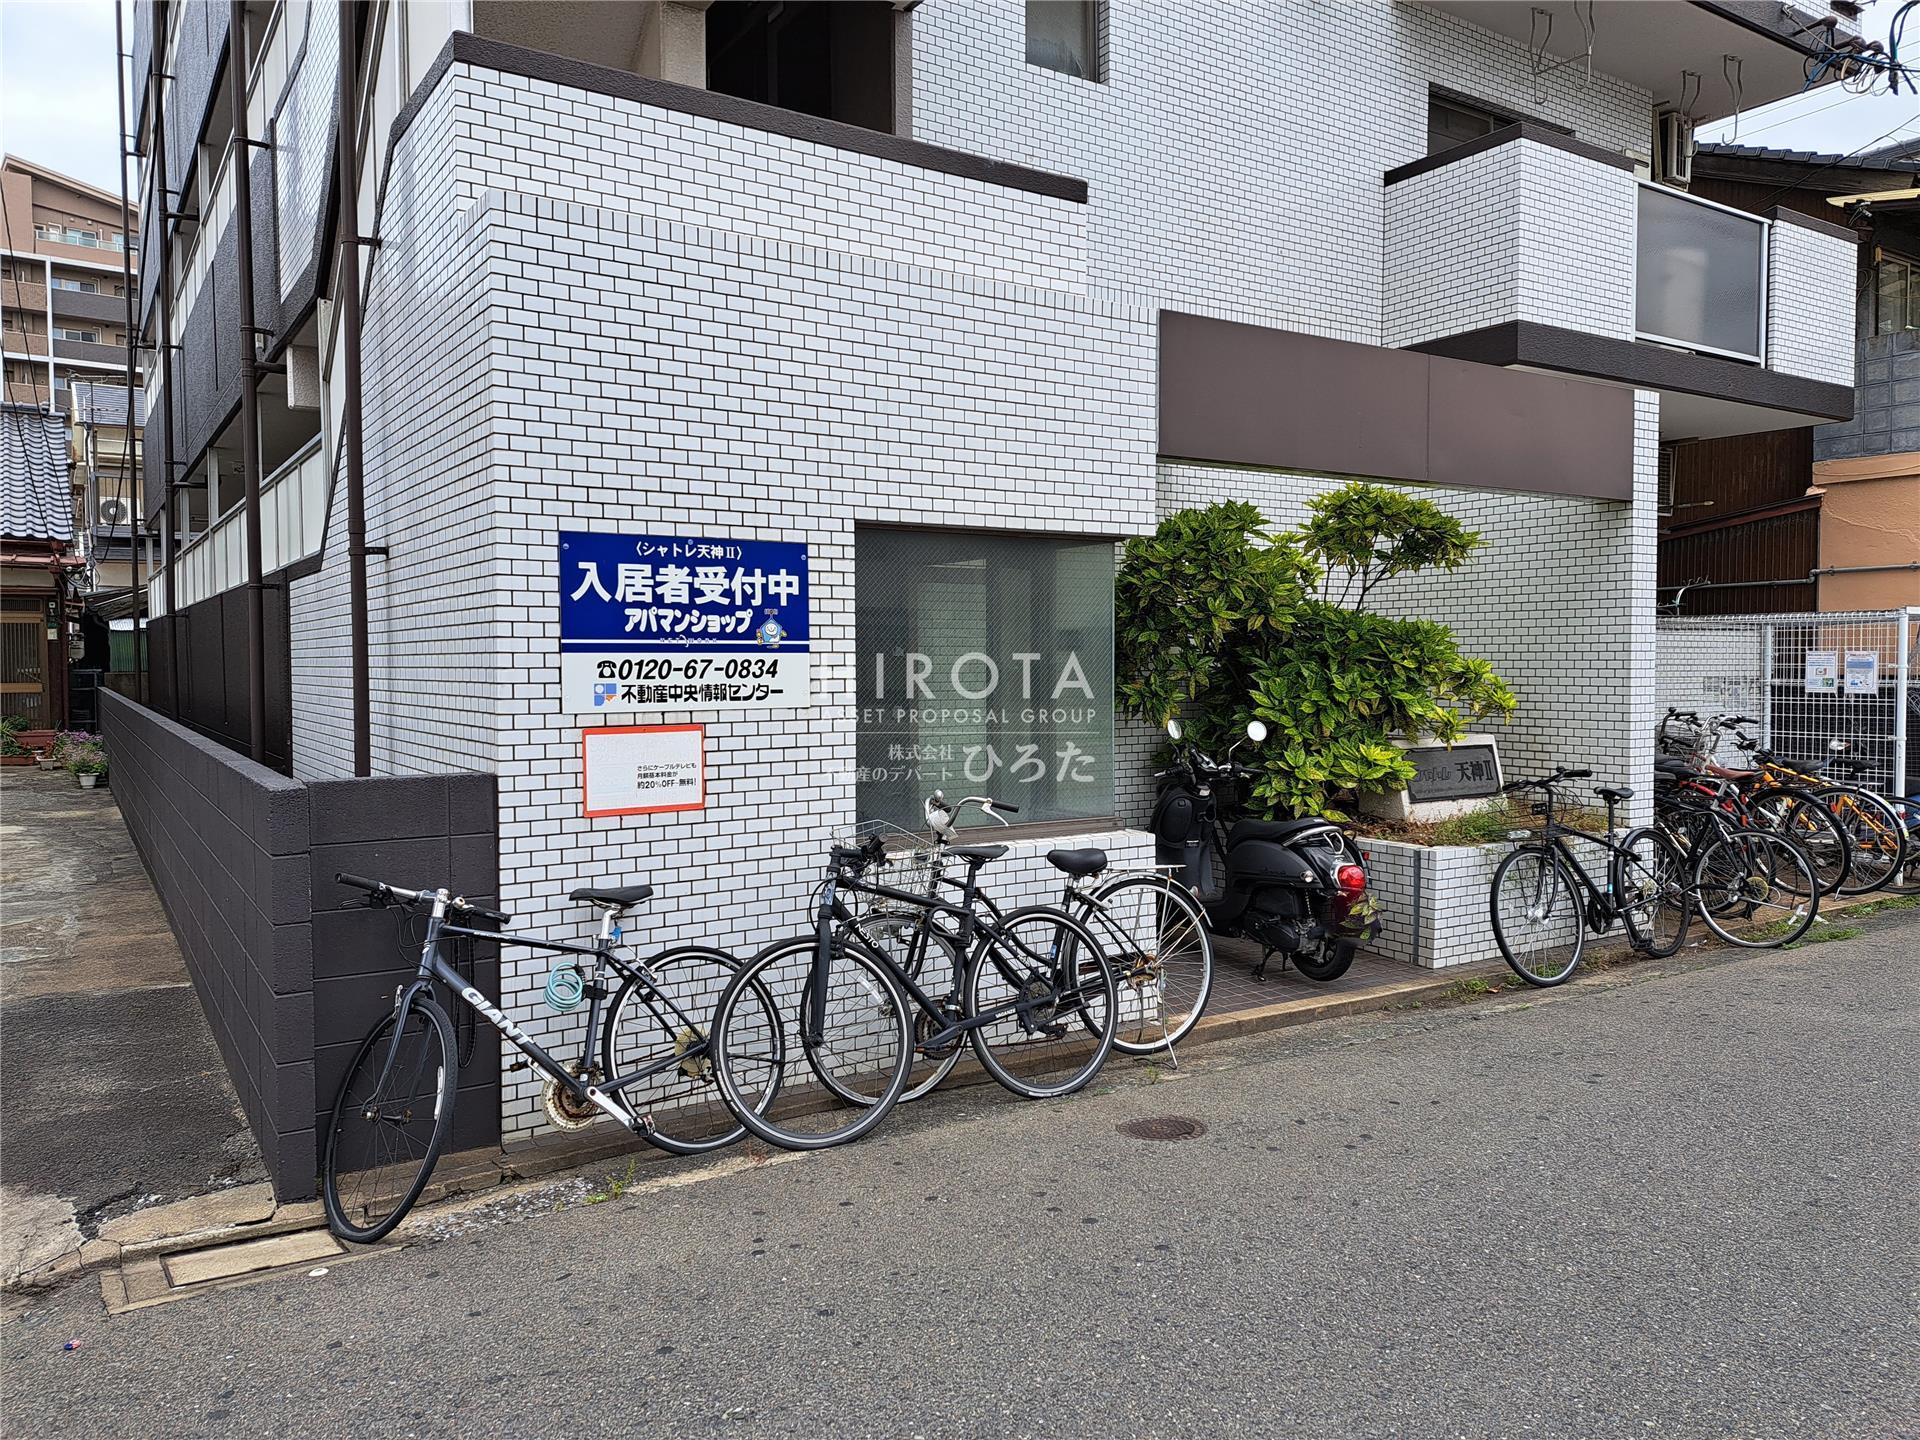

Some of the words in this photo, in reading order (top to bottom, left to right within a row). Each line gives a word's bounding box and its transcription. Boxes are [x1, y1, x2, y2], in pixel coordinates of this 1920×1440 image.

[571, 561, 800, 607] 入居者受付中
[624, 606, 753, 634] アパマンショップ
[618, 658, 779, 681] 0120-67-0834
[621, 683, 784, 704] 不動産中央情報センター
[855, 923, 879, 948] NESTO
[462, 987, 534, 1045] GIANT
